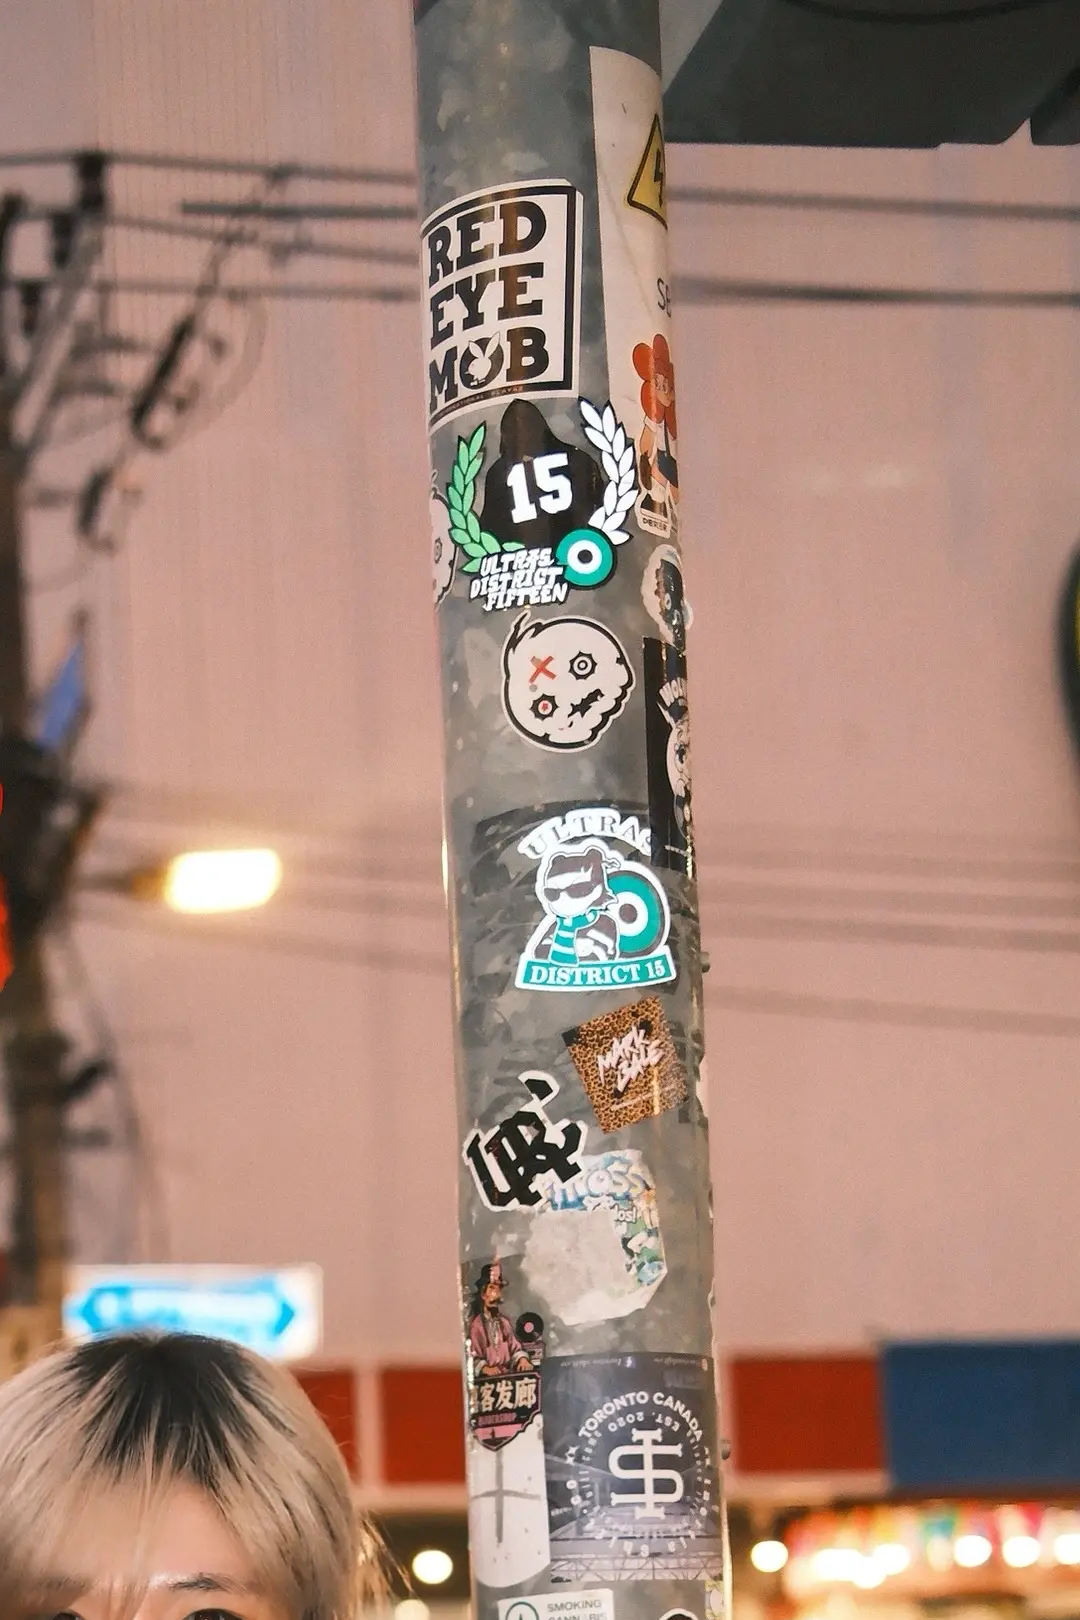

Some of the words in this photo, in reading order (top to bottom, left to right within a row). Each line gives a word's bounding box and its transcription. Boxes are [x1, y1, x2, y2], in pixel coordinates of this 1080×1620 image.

[428, 200, 547, 289] RED
[430, 262, 545, 351] EYE
[429, 326, 550, 414] MOB
[507, 452, 573, 524] 15
[480, 548, 555, 577] ULTRAS
[470, 566, 565, 599] DISTRICT
[482, 582, 569, 611] FIFTEEN
[524, 812, 651, 857] ULTRAS
[529, 964, 641, 985] DISTRICT
[645, 959, 666, 979] 15
[578, 1391, 649, 1439] TORONTO
[653, 1392, 703, 1442] CANADA
[608, 1411, 644, 1432] 2020
[547, 1599, 602, 1612] SMOKING
